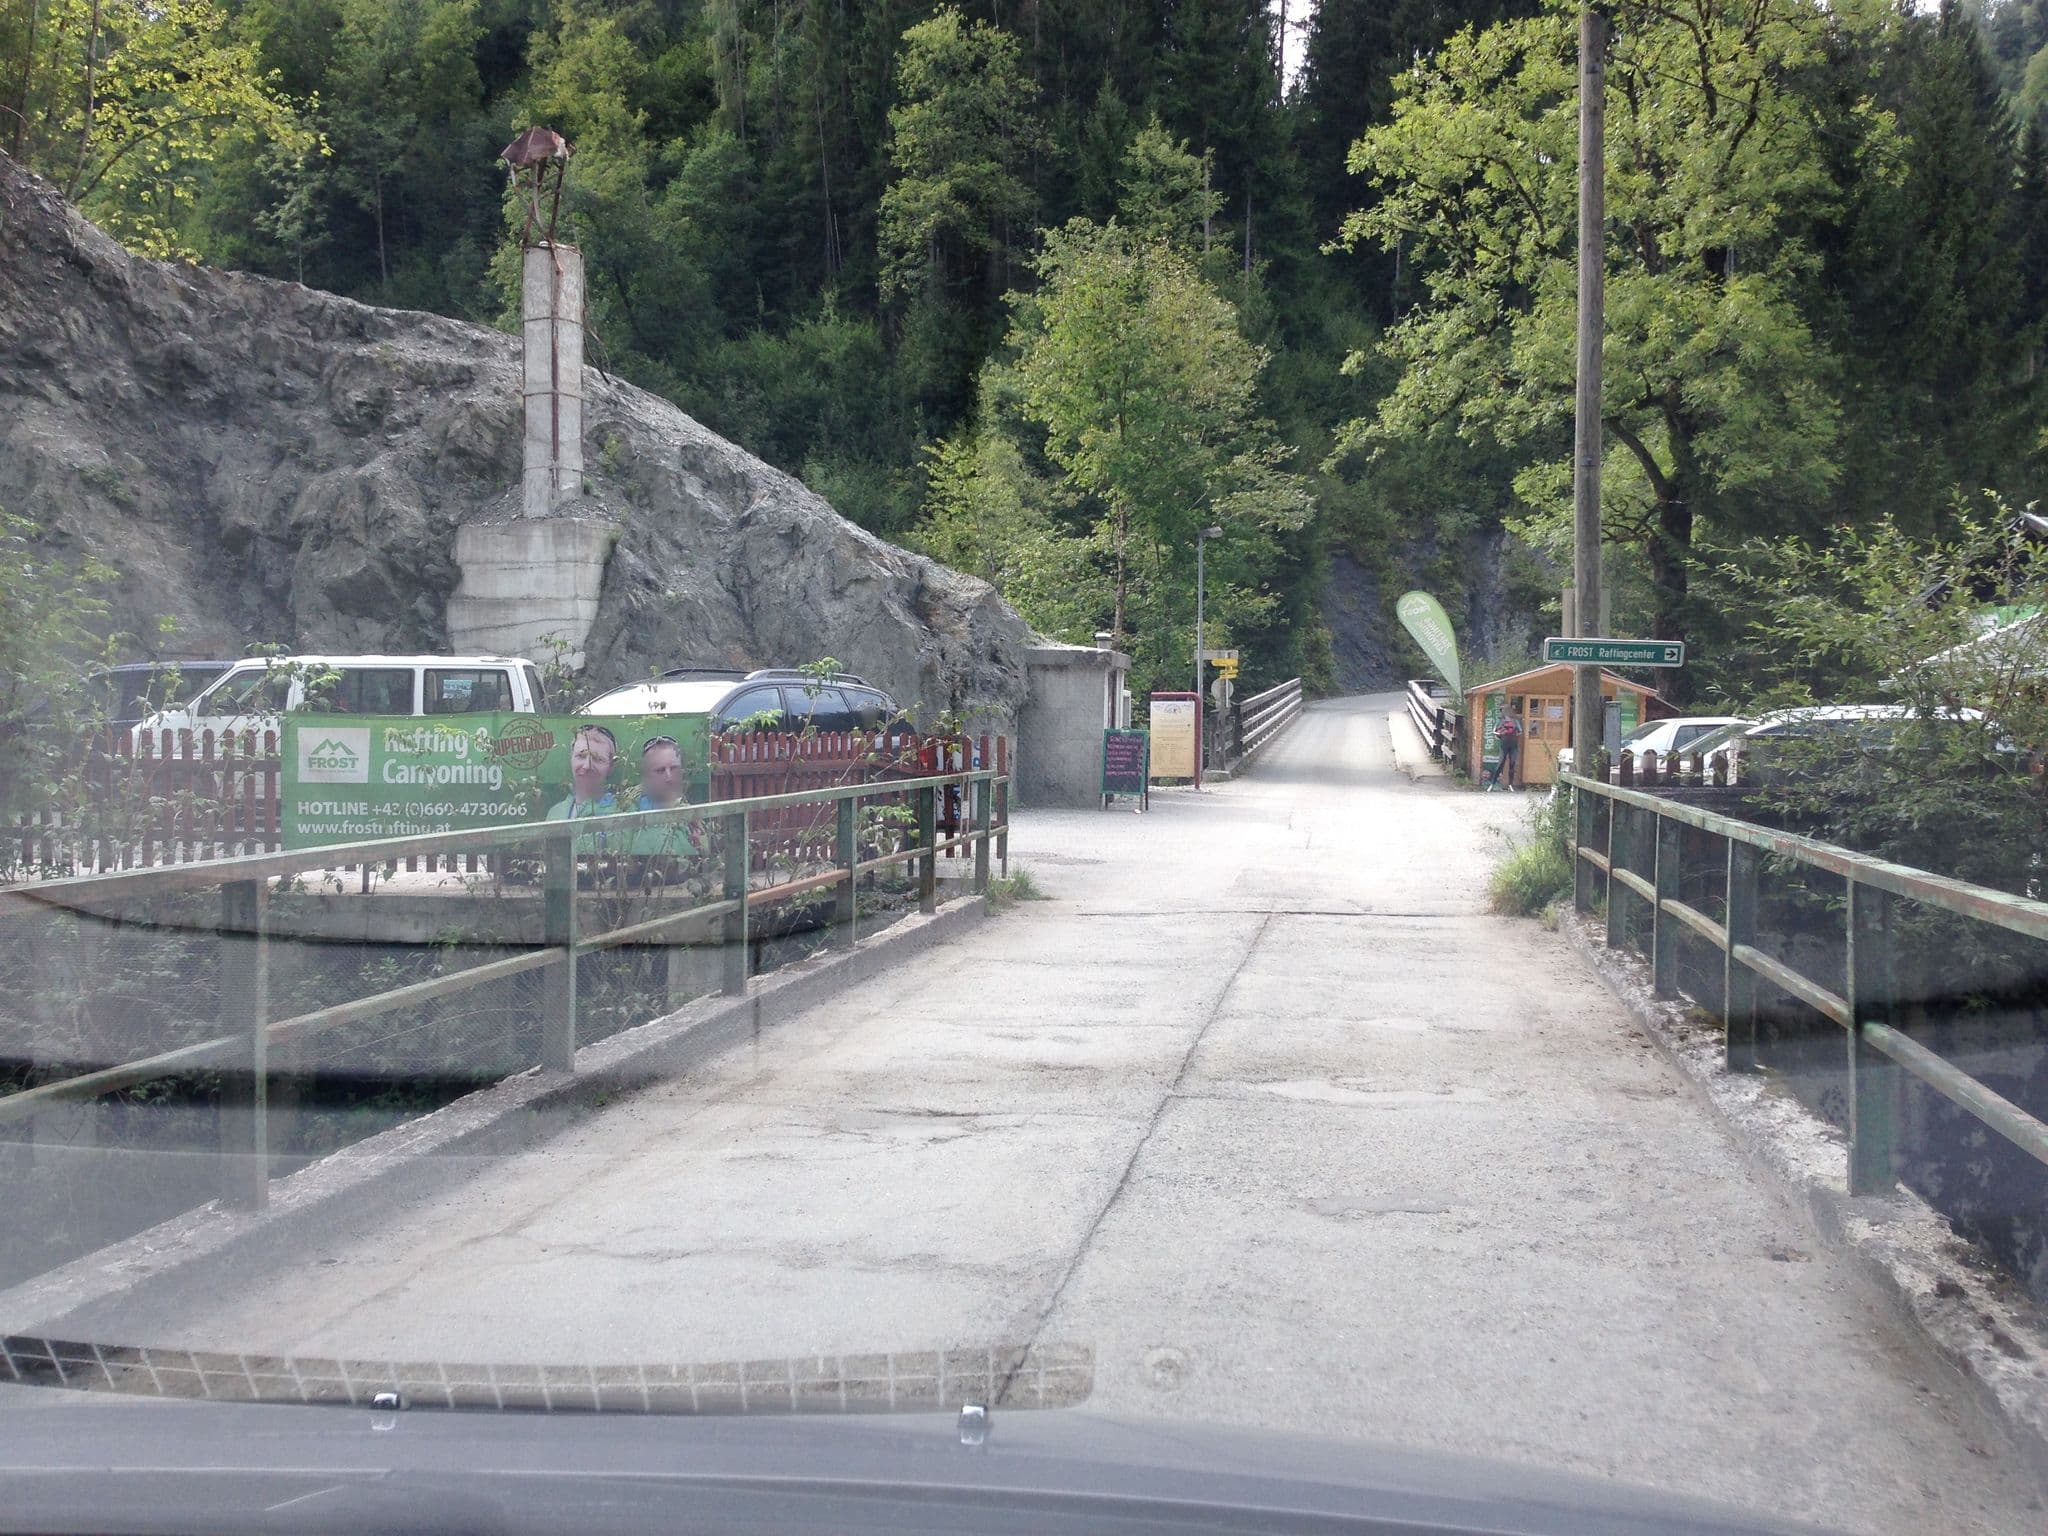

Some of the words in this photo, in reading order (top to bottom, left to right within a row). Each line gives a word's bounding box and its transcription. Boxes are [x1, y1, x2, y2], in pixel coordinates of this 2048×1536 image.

[1568, 646, 1594, 657] FROST
[1599, 647, 1656, 661] Raftingcenter
[384, 727, 469, 759] Rafting
[308, 757, 359, 769] FROST
[382, 758, 503, 791] Canyoning
[297, 801, 369, 816] HOTLINE
